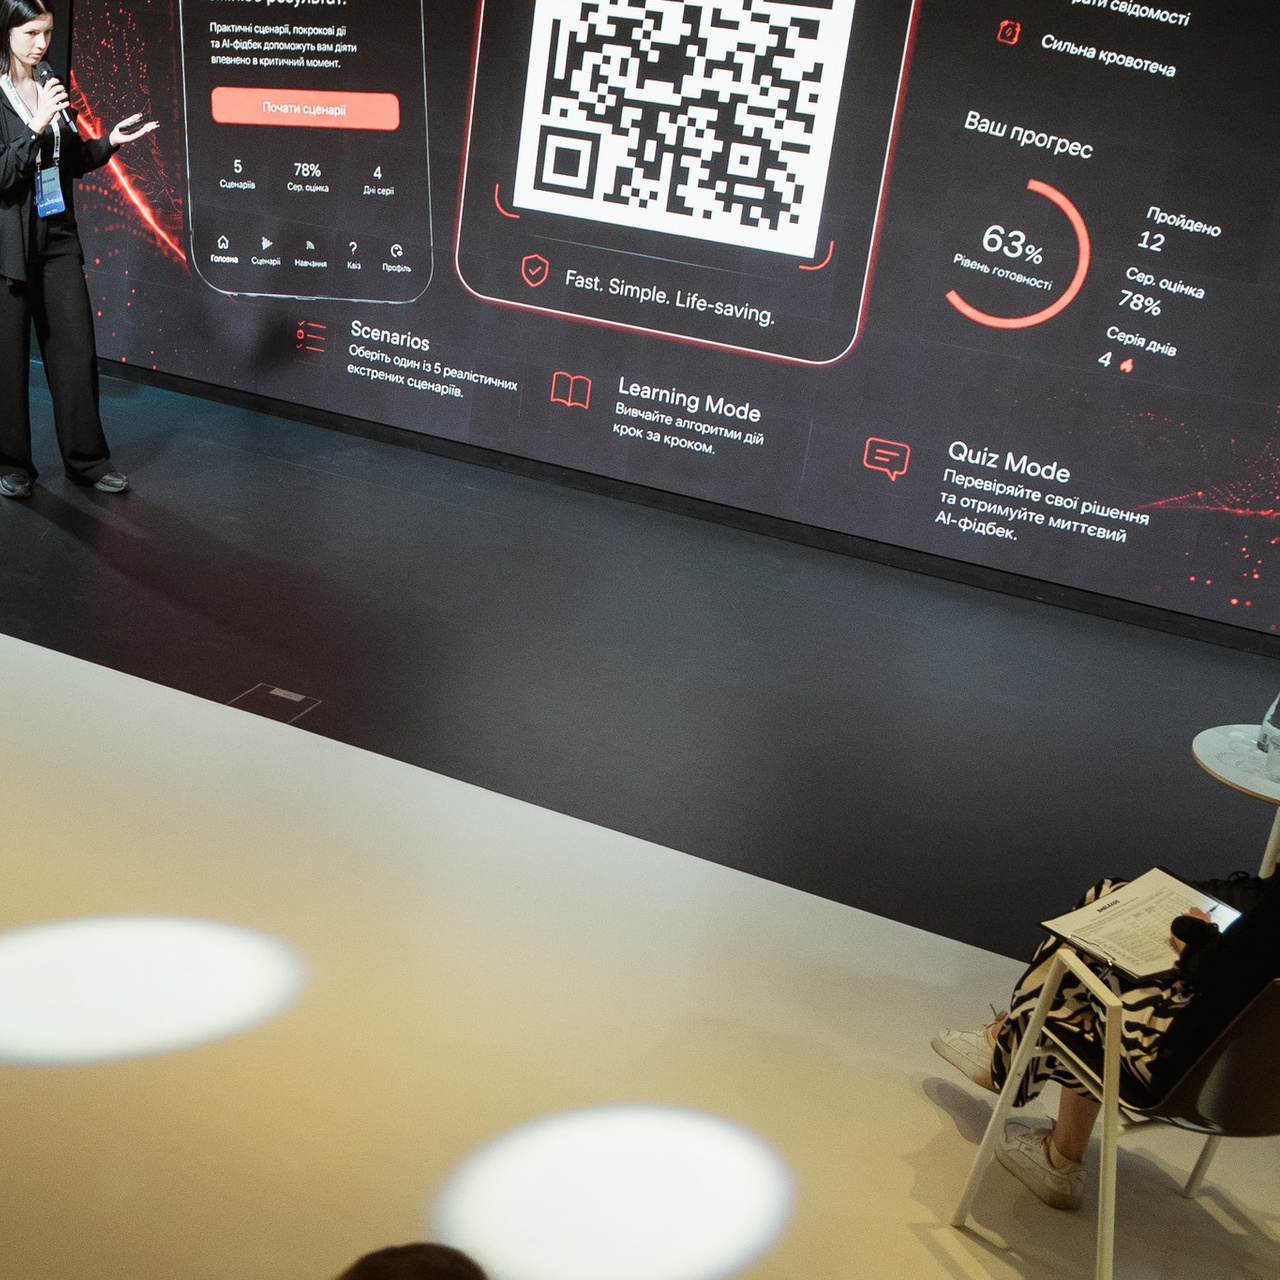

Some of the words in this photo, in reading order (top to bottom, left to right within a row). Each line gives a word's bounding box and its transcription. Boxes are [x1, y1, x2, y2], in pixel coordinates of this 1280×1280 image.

[1110, 0, 1191, 26] свідомості
[210, 22, 252, 34] Практичні
[254, 24, 291, 35] сценарії,
[293, 26, 334, 36] покрокові
[336, 26, 346, 37] дії
[211, 40, 220, 48] та
[263, 42, 315, 52] допоможуть
[317, 43, 333, 51] вам
[335, 44, 357, 53] діяти
[211, 56, 251, 65] впевнено
[253, 57, 258, 65] в
[260, 57, 304, 66] критичний
[306, 59, 340, 67] момент.
[1042, 34, 1096, 58] Сильна
[1099, 50, 1176, 77] кровотеча
[263, 101, 300, 113] Почати
[303, 105, 346, 117] сценарії
[965, 111, 1007, 137] Ваш
[1010, 126, 1093, 158] прогрес
[234, 159, 242, 173] 5
[294, 163, 321, 177] 78%
[374, 166, 382, 179] 4
[220, 179, 255, 190] Сценаріїв
[287, 182, 304, 192] Сер.
[363, 186, 375, 194] Дні
[377, 187, 394, 196] серії
[1147, 206, 1221, 238] Пройдено
[983, 225, 1042, 264] 63%
[1138, 231, 1165, 251] 12
[954, 253, 990, 273] Рівень
[992, 267, 1052, 290] готовності
[1126, 267, 1155, 285] Сер.
[1159, 279, 1205, 299] оцінка
[566, 270, 603, 291] Fast.
[609, 278, 669, 304] Simple.
[676, 291, 774, 327] Life-saving.
[1119, 290, 1161, 316] 78%
[351, 320, 429, 351] Scenarios
[1107, 326, 1145, 347] Серія
[1146, 341, 1177, 356] днів
[349, 344, 391, 363] Оберіть
[393, 356, 420, 369] один
[423, 360, 431, 372] із
[434, 363, 441, 374] 5
[443, 367, 517, 391] реалістичних
[1098, 352, 1112, 367] 4
[347, 364, 404, 384] екстрених
[407, 378, 463, 397] сценаріїв.
[619, 377, 699, 413] Learning
[705, 395, 760, 422] Mode
[616, 402, 673, 425] Вивчайте
[675, 418, 742, 440] алгоритми
[743, 432, 764, 445] дій
[613, 424, 643, 438] крок
[646, 431, 660, 442] за
[664, 435, 715, 454] кроком.
[949, 441, 999, 468] Quiz
[1005, 452, 1070, 483] Mode
[944, 469, 1041, 503] Перевіряйте
[1045, 494, 1079, 509] свої
[1081, 501, 1149, 525] рішення
[941, 492, 956, 504] та
[960, 497, 1044, 524] отримуйте
[1049, 517, 1126, 542] миттєвий
